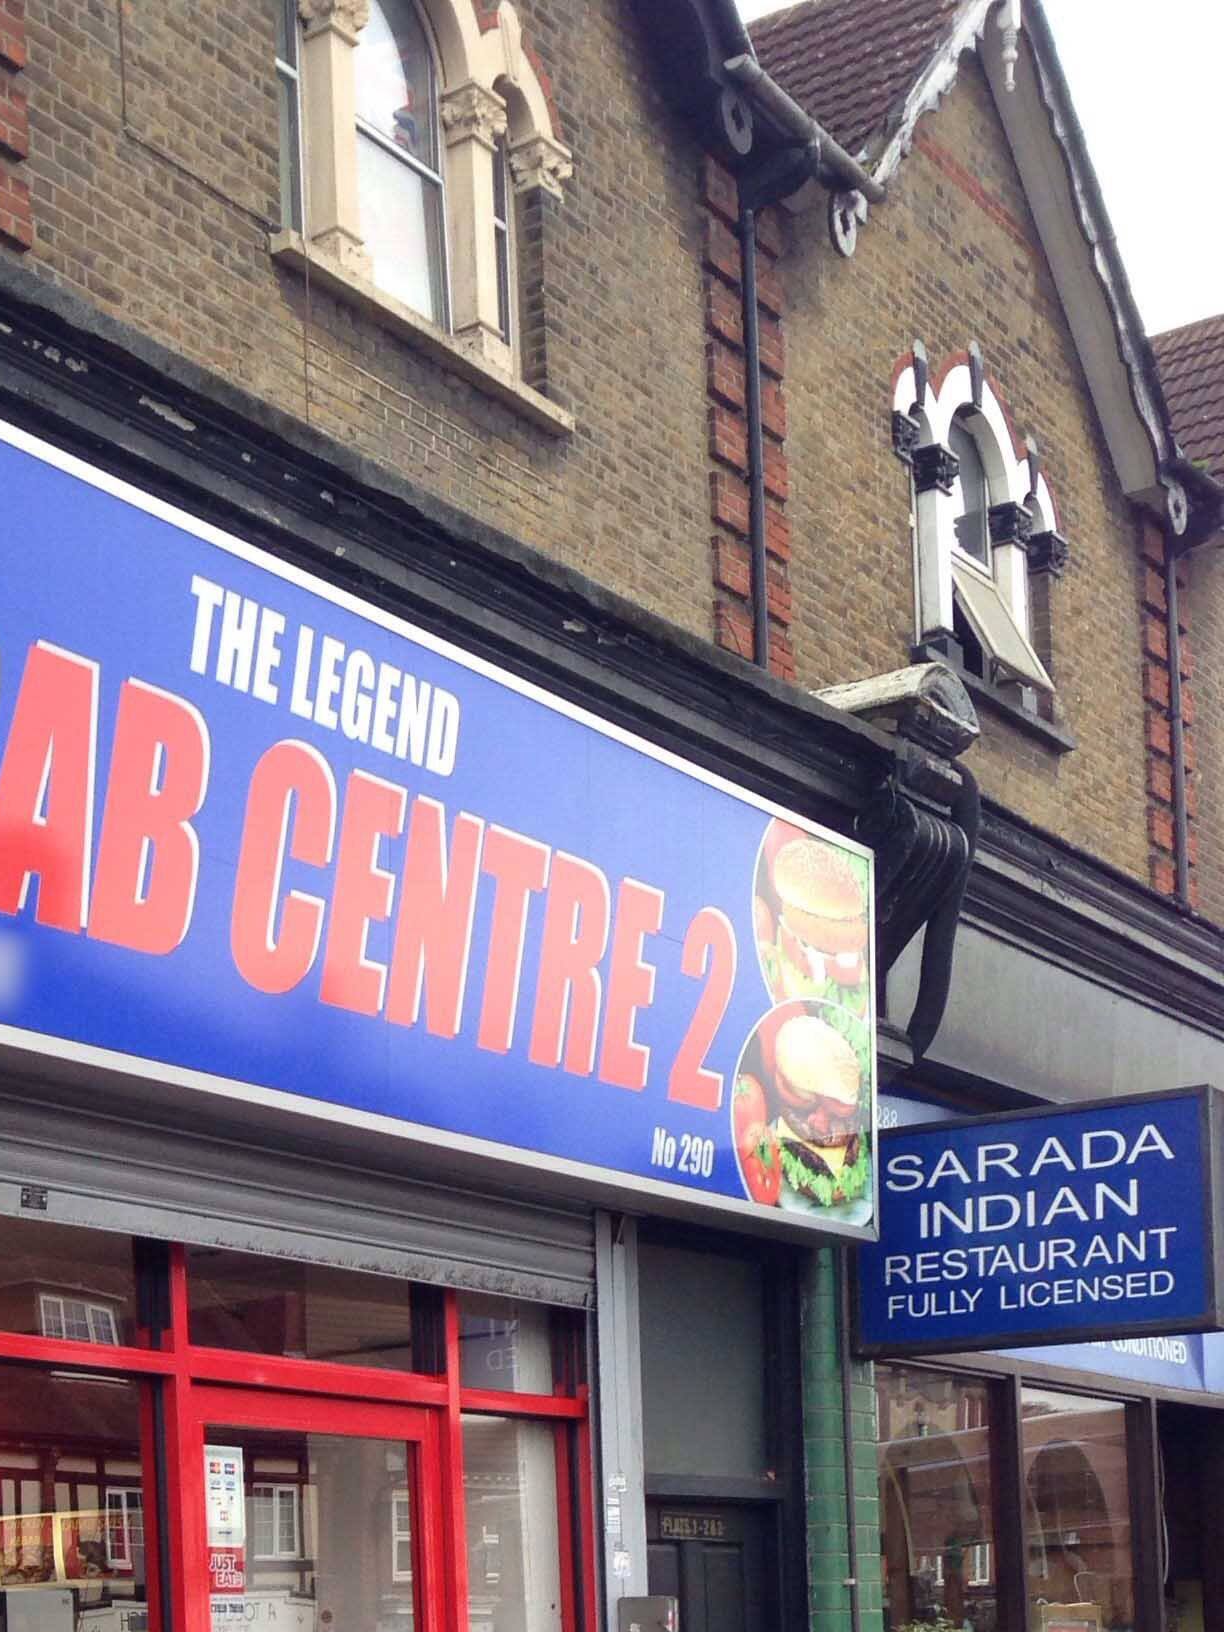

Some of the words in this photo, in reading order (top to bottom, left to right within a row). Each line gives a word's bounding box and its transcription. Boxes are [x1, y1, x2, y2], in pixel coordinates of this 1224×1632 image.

[190, 575, 286, 706] THE
[289, 622, 461, 777] LEGEND
[229, 738, 665, 1092] CENTRE
[667, 906, 738, 1112] 2
[651, 1127, 676, 1169] No
[678, 1132, 714, 1178] 290
[885, 1124, 1175, 1193] SARADA
[919, 1178, 1139, 1239] INDIAN
[885, 1226, 1178, 1286] RESTAURANT
[888, 1288, 983, 1320] FULLY
[999, 1270, 1175, 1310] LICENSED
[210, 1554, 236, 1573] JUST
